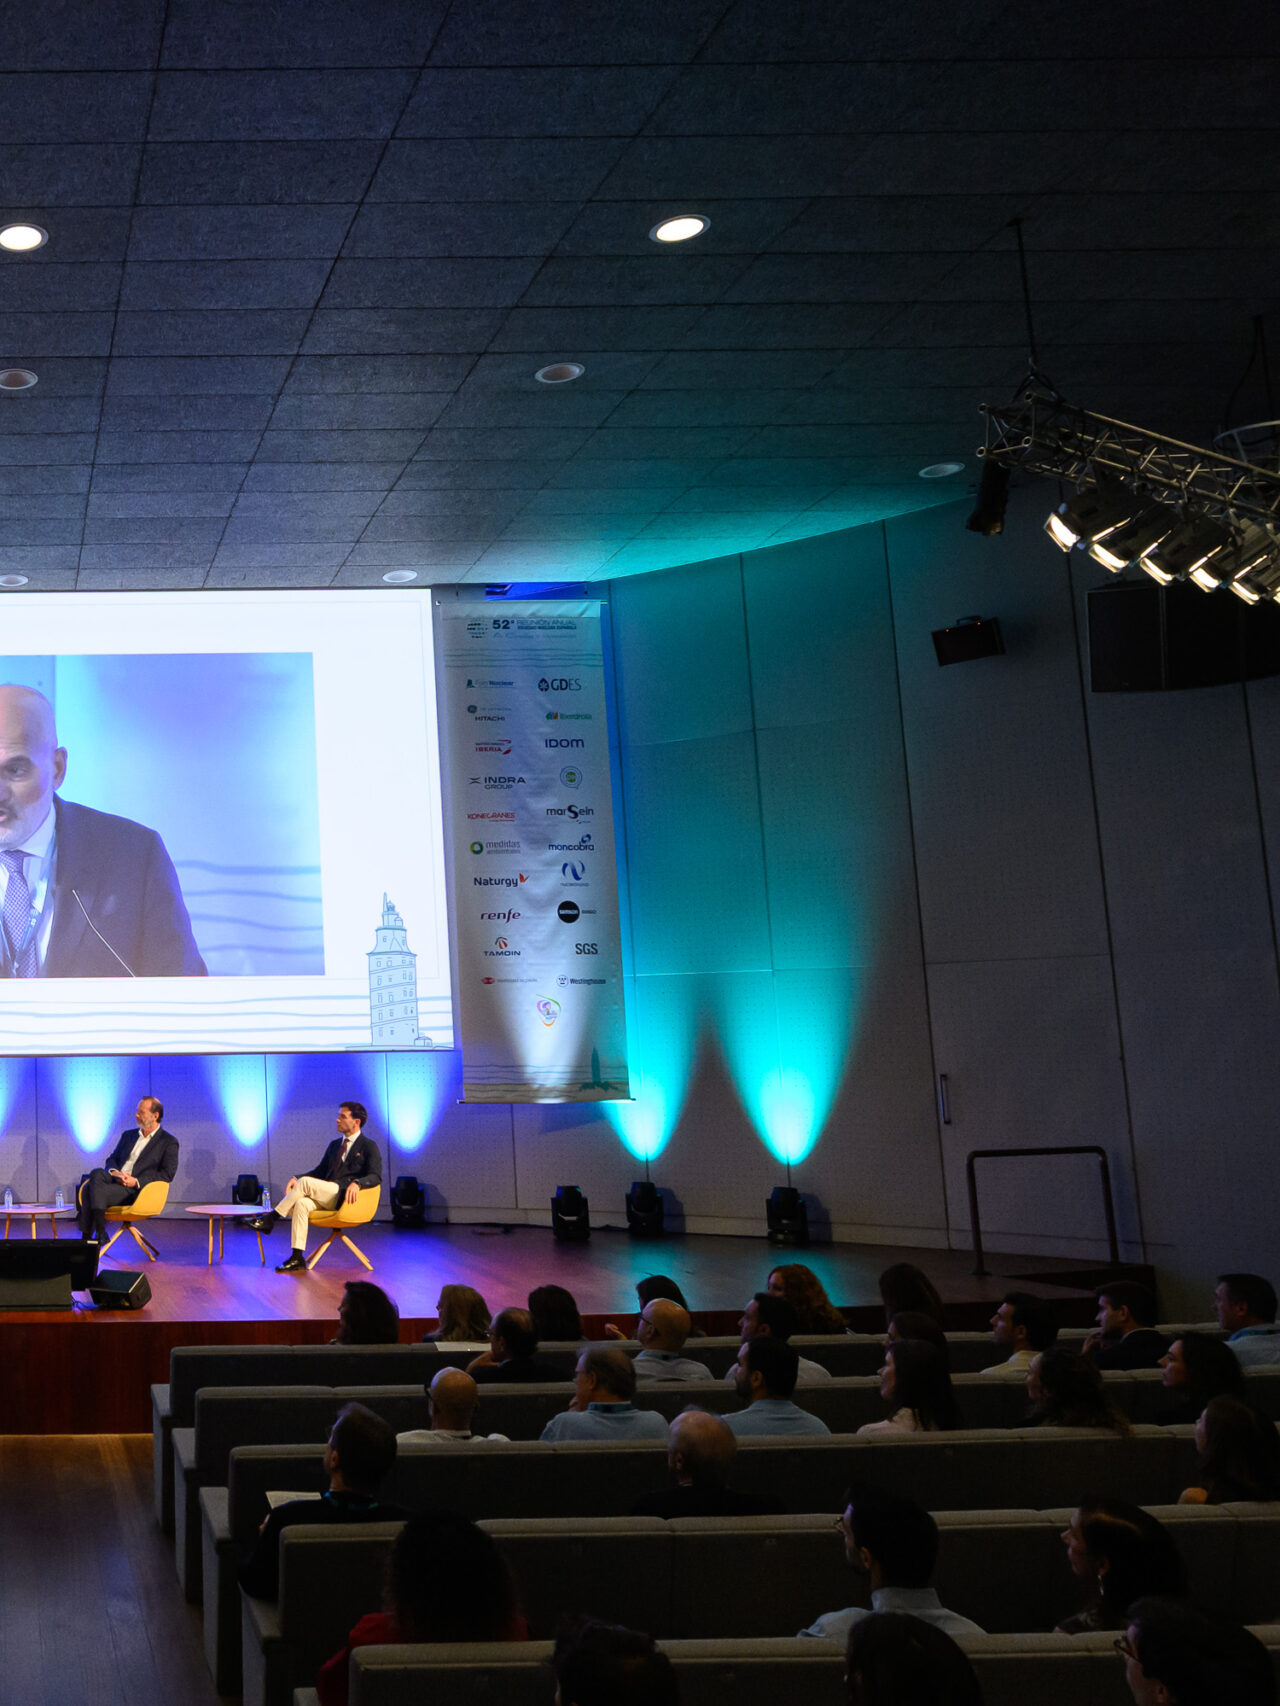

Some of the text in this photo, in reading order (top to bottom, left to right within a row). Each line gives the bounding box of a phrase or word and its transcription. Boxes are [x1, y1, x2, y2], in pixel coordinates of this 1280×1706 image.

[551, 679, 582, 691] GDES
[545, 739, 584, 748] IDOM
[484, 776, 527, 784] INDRA
[546, 804, 594, 819] marSein
[548, 842, 594, 851] moncobra
[474, 877, 518, 887] Naturgy
[480, 908, 521, 924] renfe
[575, 943, 598, 955] SGS
